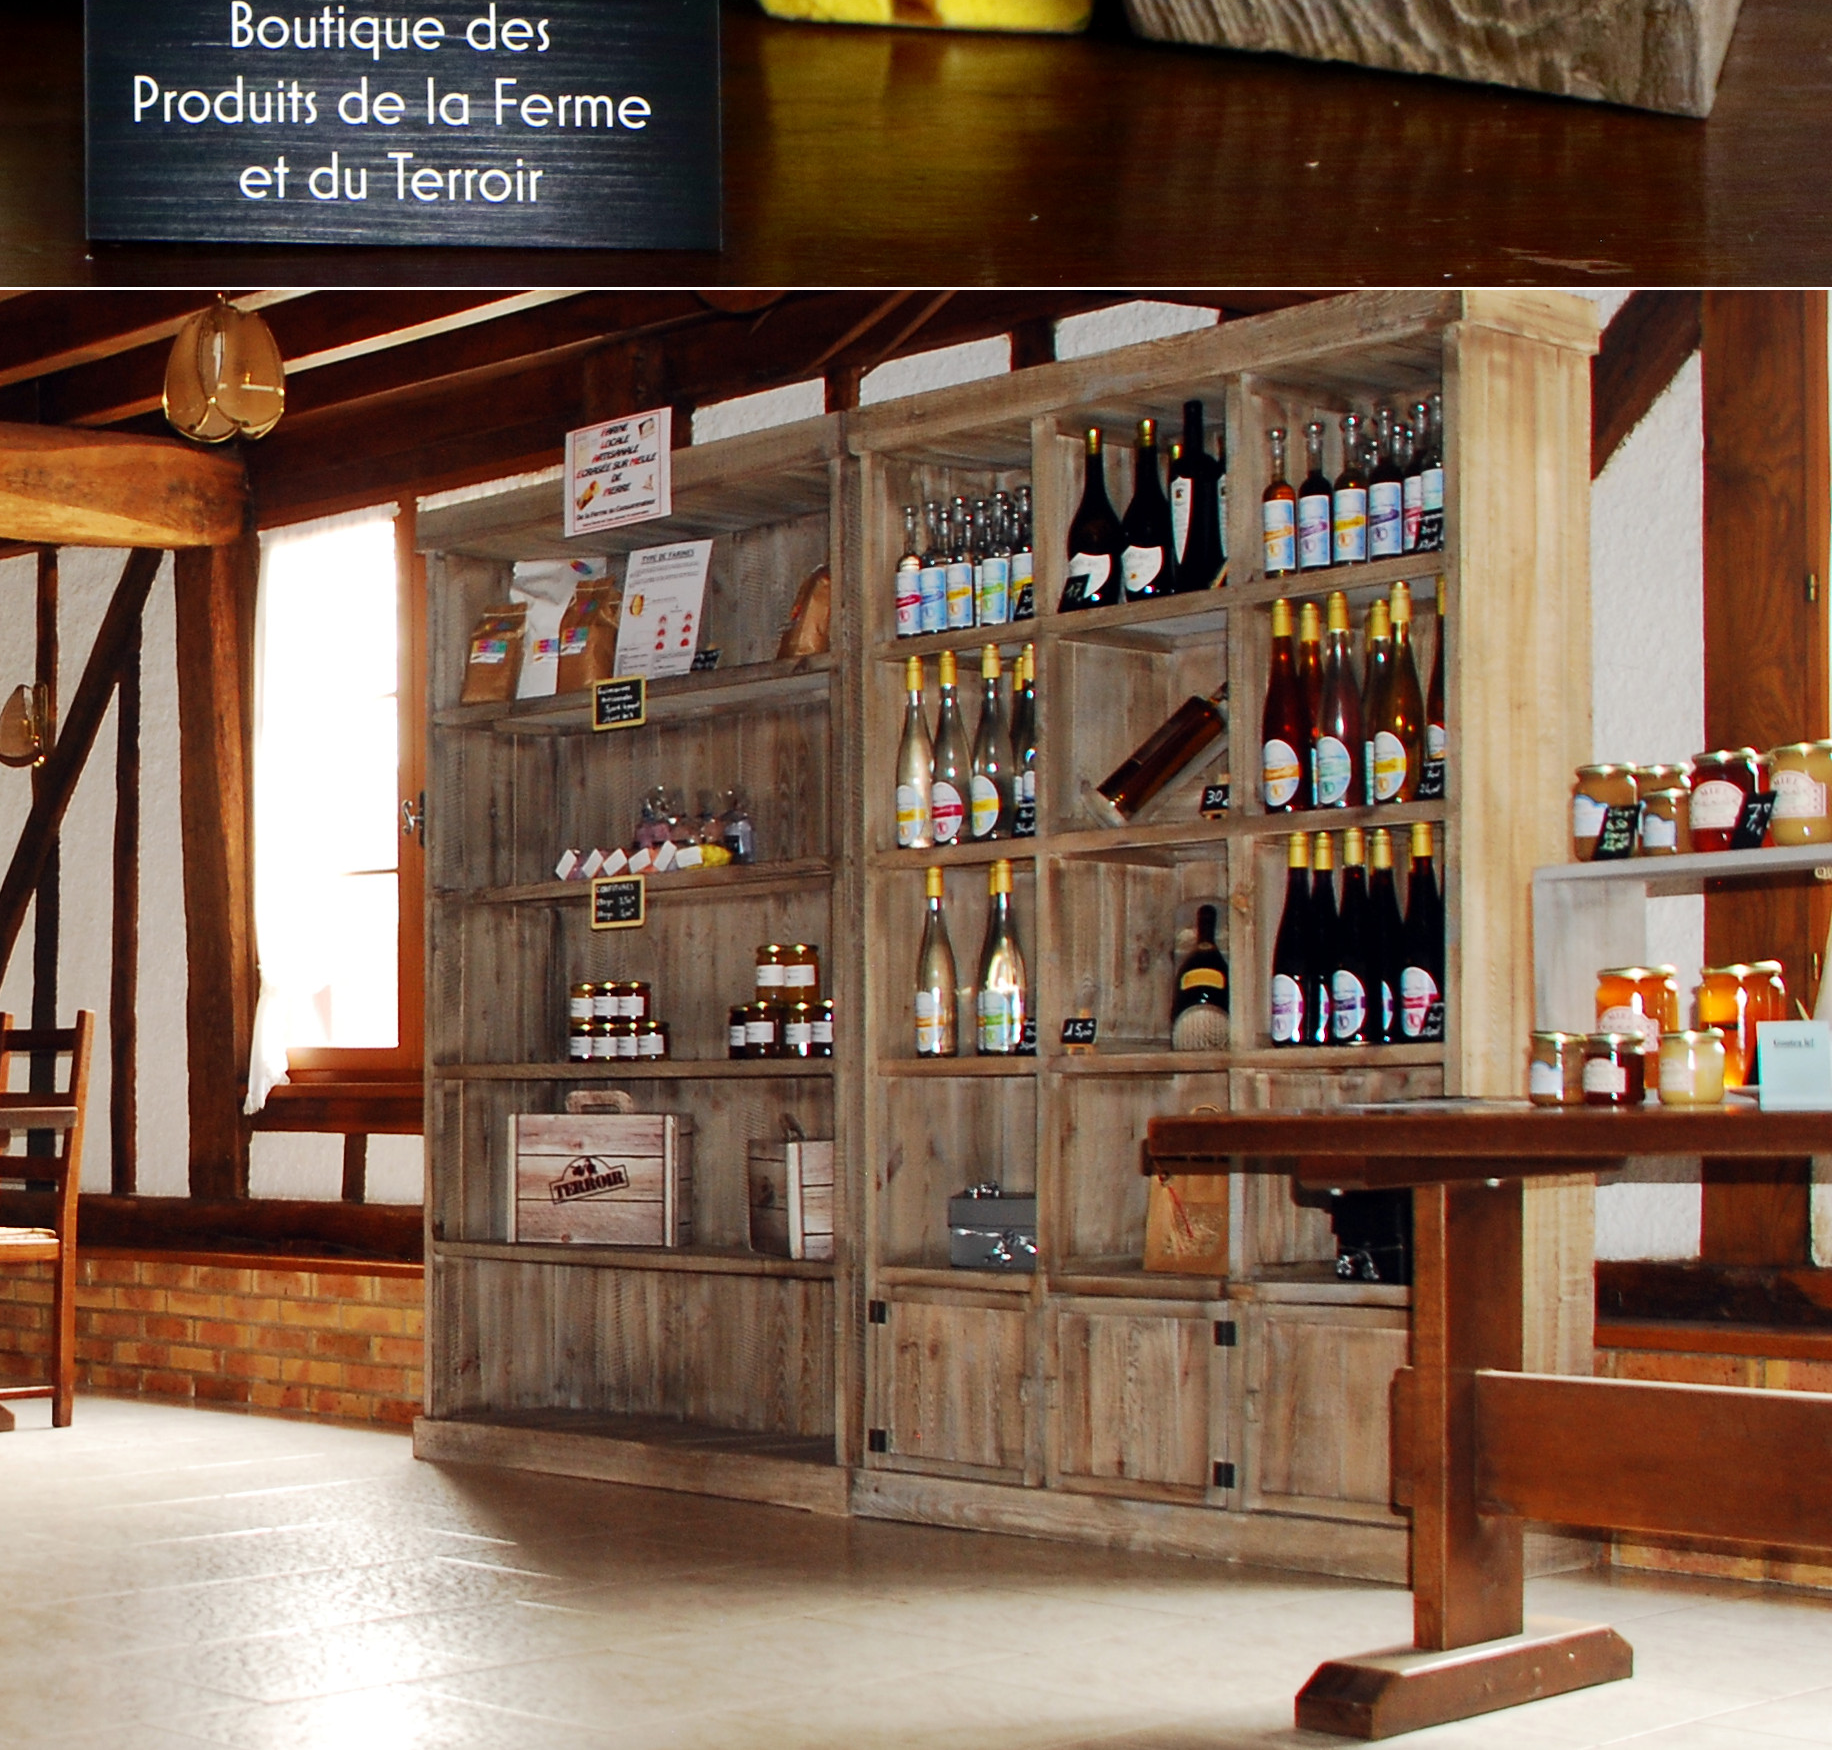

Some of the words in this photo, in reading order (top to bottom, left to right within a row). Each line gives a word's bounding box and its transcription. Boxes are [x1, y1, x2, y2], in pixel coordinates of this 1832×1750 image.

[230, 0, 446, 61] Boutique
[466, 3, 551, 52] des
[133, 75, 318, 125] Produits
[337, 76, 406, 126] de
[426, 76, 471, 126] la
[494, 78, 653, 130] Ferme
[238, 158, 290, 200] et
[308, 151, 368, 201] du
[386, 151, 544, 203] Terroir
[591, 443, 640, 464] ARTISANALE
[599, 434, 631, 450] LOCALE
[611, 458, 630, 471] SUR
[629, 451, 658, 467] MEULE
[553, 1170, 625, 1200] TERROIR
